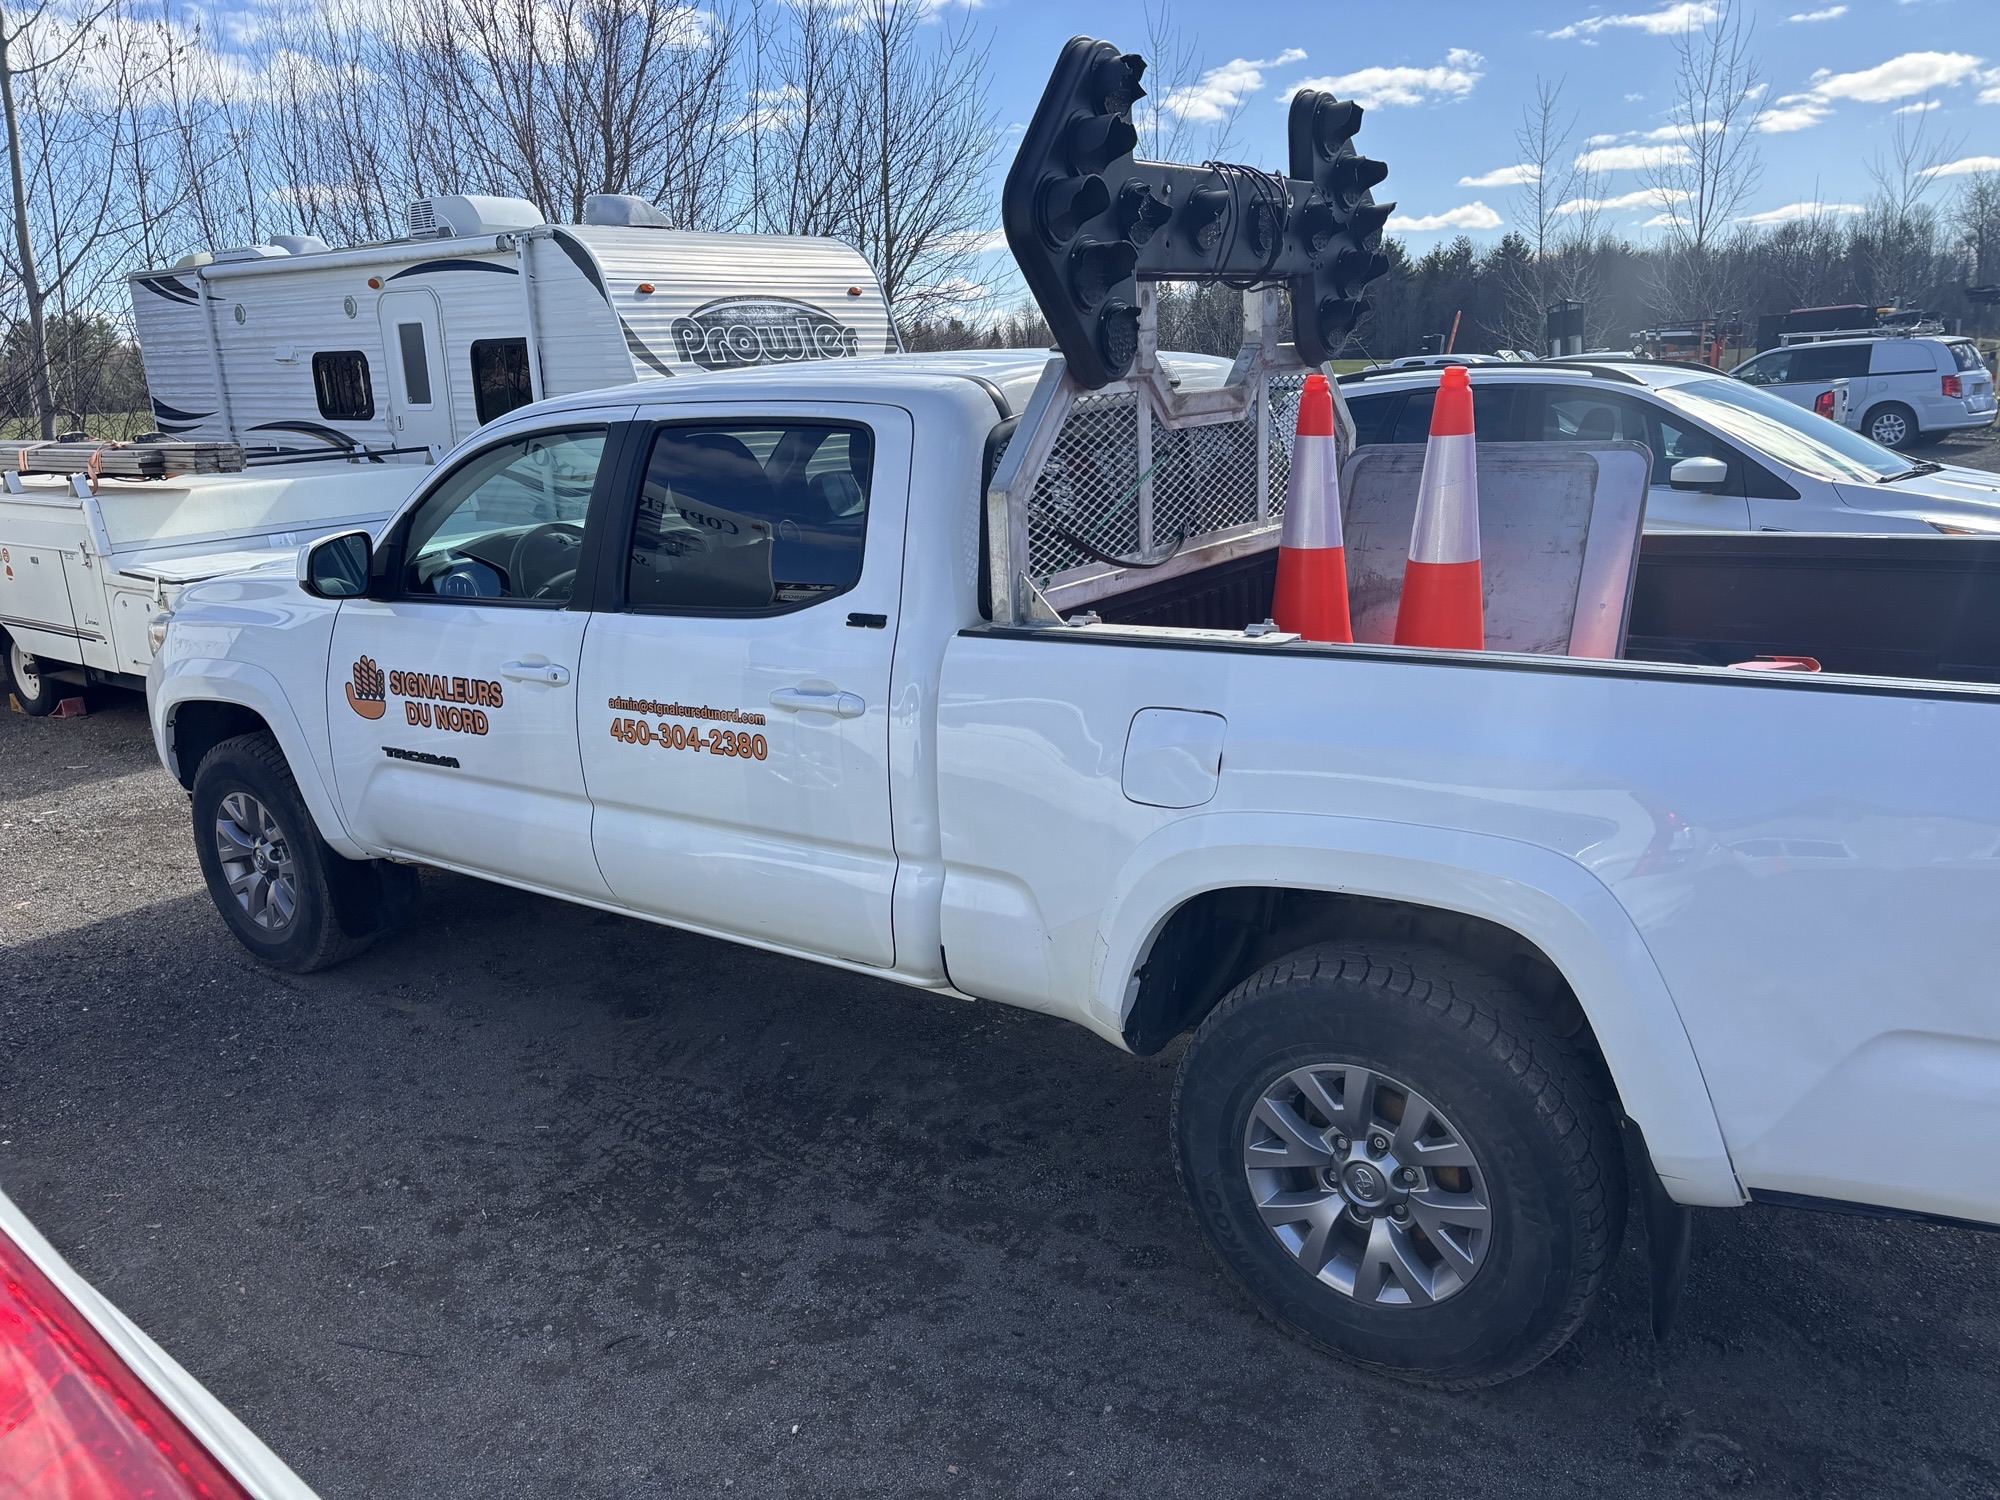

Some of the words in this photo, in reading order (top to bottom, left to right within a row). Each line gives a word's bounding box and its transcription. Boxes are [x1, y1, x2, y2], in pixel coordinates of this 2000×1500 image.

[670, 316, 860, 363] Prowler
[389, 670, 504, 708] SIGNALEURS
[405, 701, 432, 727] DU
[434, 704, 489, 735] NORD
[608, 696, 766, 725] admin@signaleursdunord.com
[381, 746, 460, 769] TACOMA
[610, 718, 768, 761] 450-304-2380
